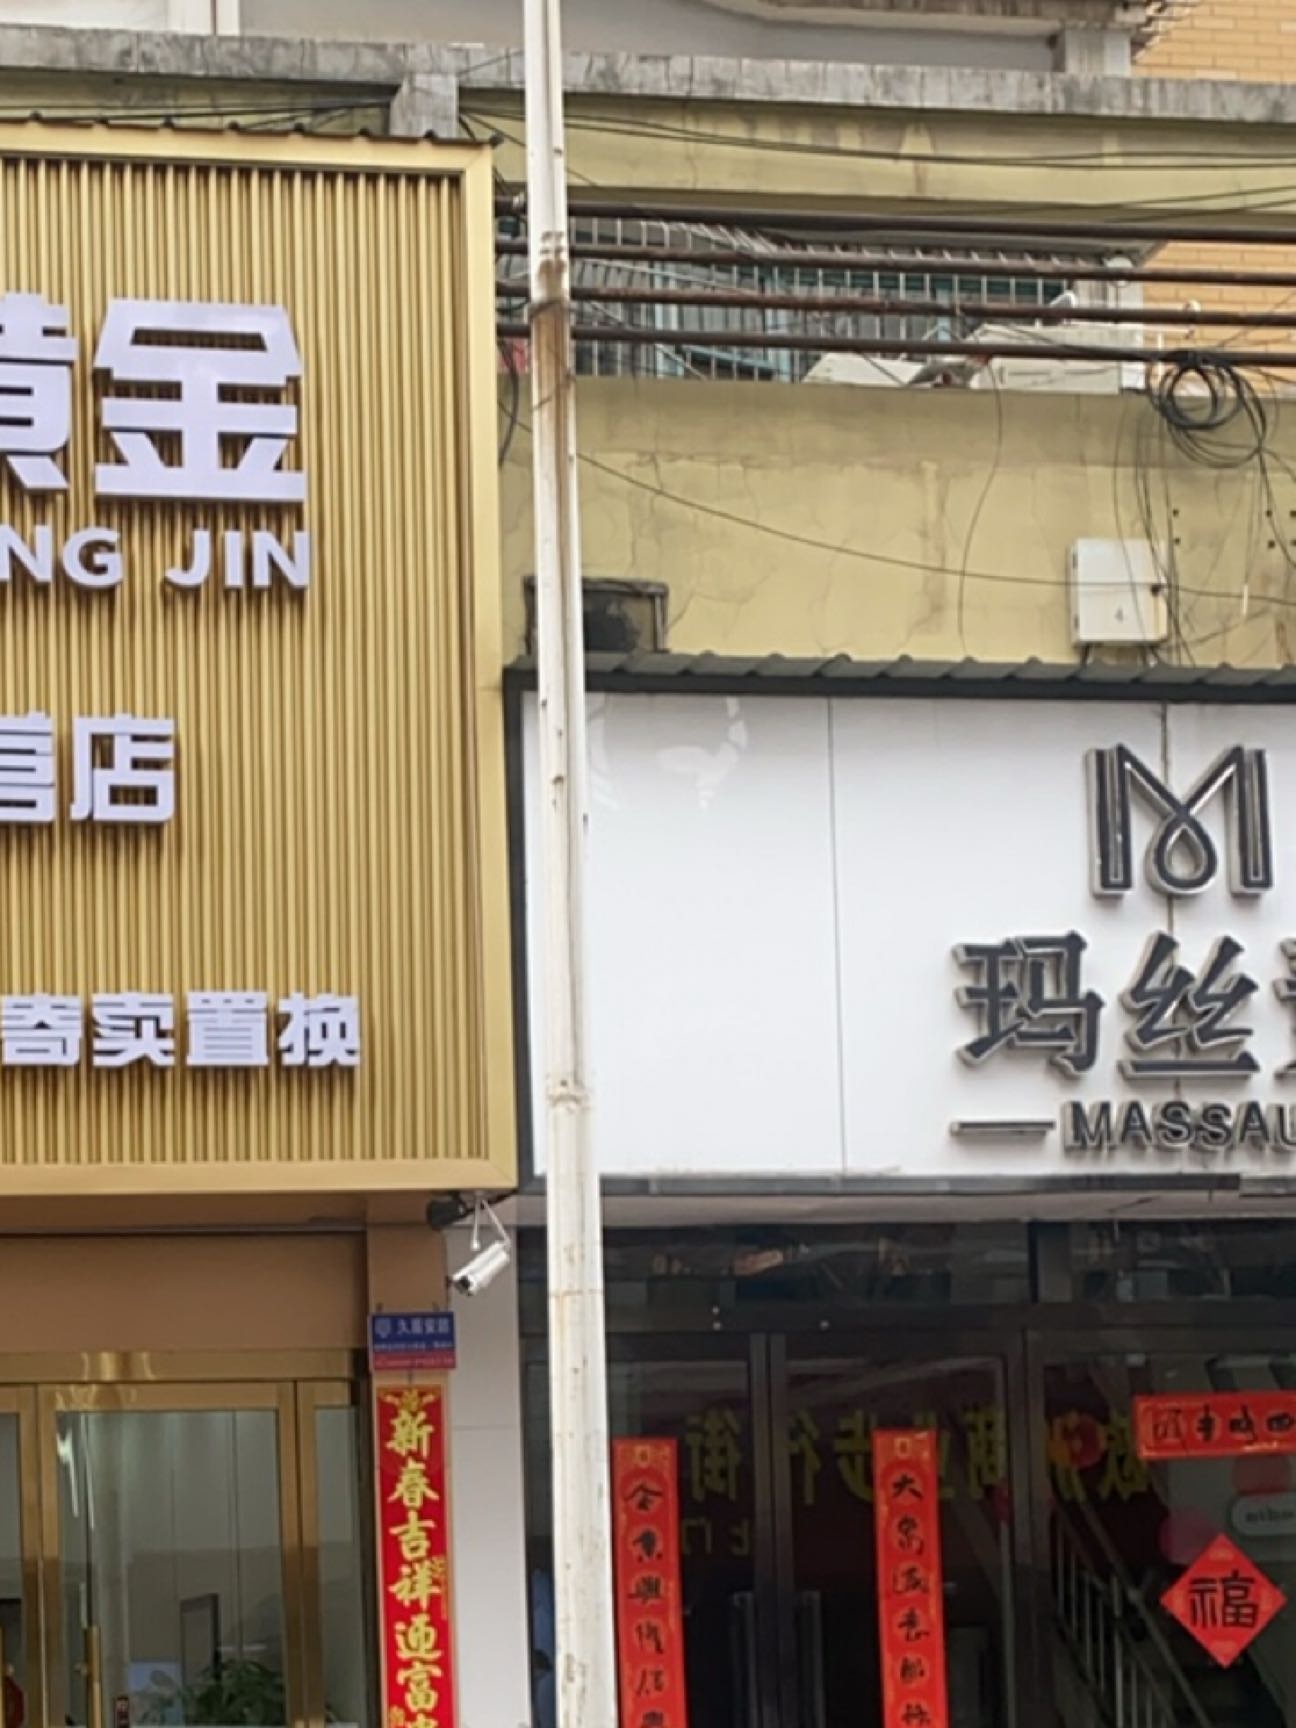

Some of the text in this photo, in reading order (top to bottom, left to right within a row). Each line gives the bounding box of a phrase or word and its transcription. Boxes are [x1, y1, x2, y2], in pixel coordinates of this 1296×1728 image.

[164, 529, 312, 590] JIN
[951, 931, 1296, 1081] 玛丝
[1188, 1569, 1260, 1629] 福
